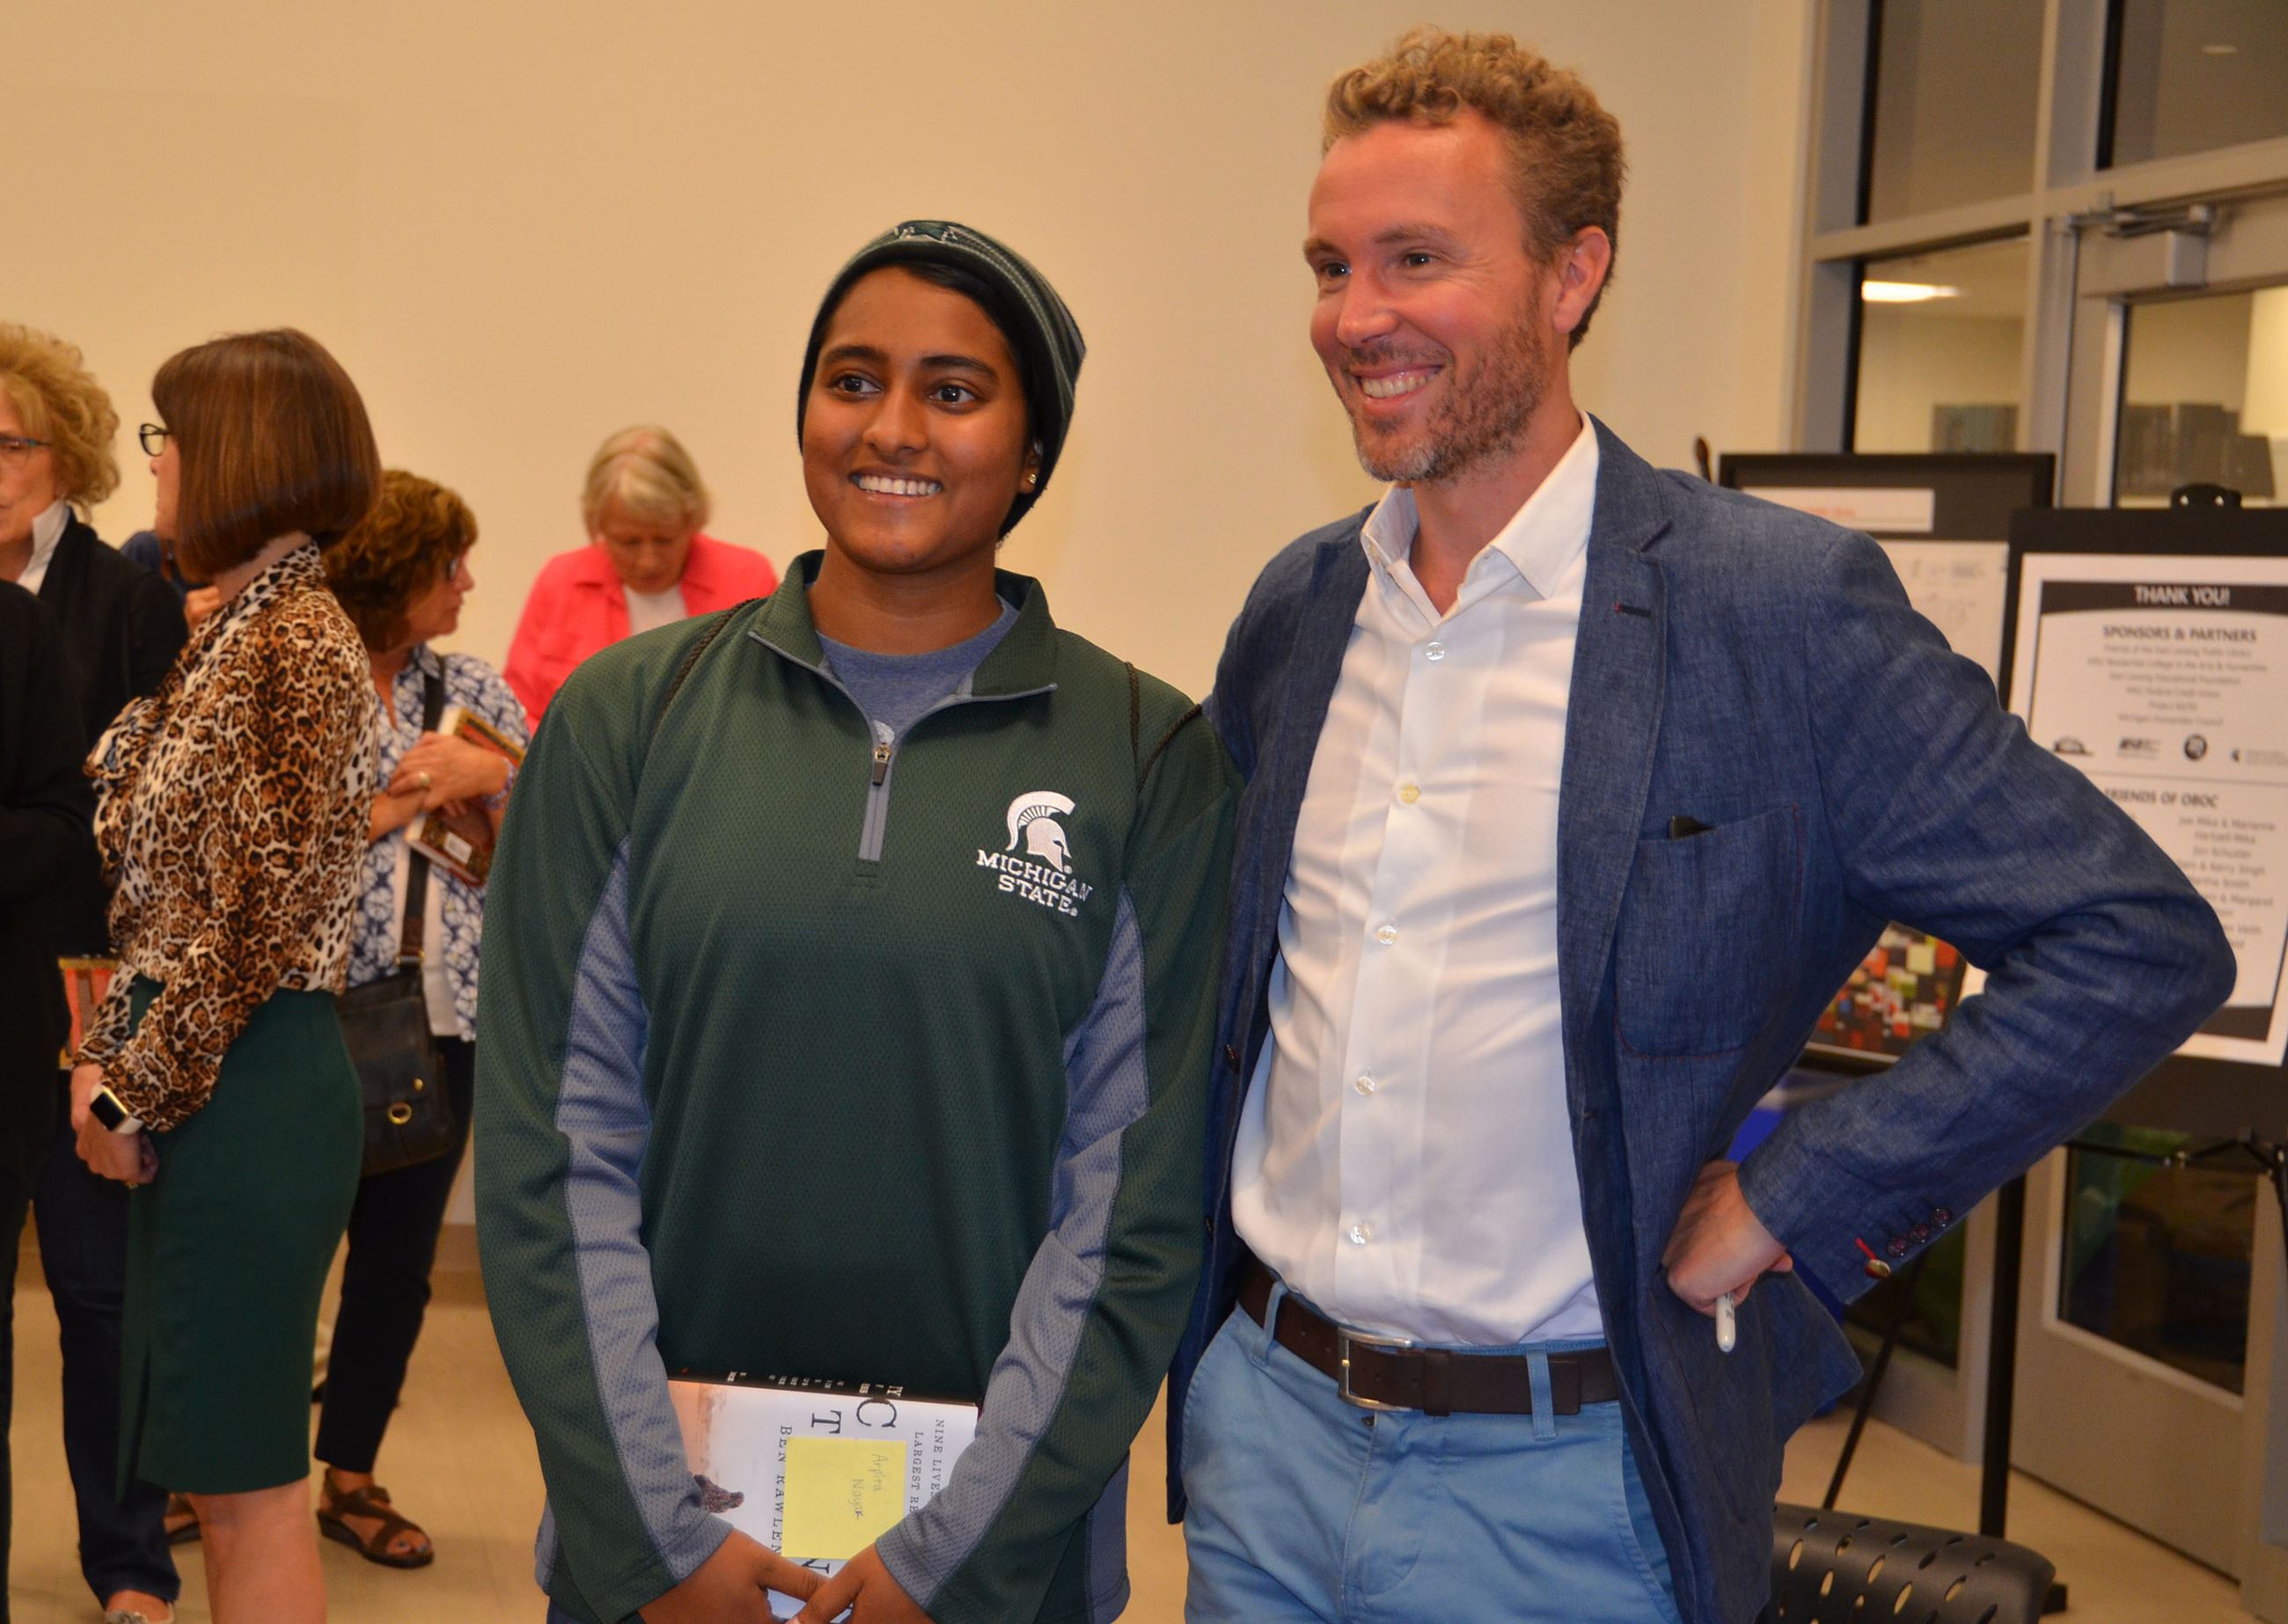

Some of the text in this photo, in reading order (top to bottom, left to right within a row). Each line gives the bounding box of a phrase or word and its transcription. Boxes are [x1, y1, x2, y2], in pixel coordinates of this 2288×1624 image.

[2133, 585, 2232, 607] THANK YOU!
[2102, 625, 2257, 643] SPONSORS & PARTNERS
[2160, 791, 2177, 805] OF
[976, 849, 1093, 901] MICHIGAN
[933, 1418, 945, 1452] NINE
[911, 1431, 924, 1490] LARGEST
